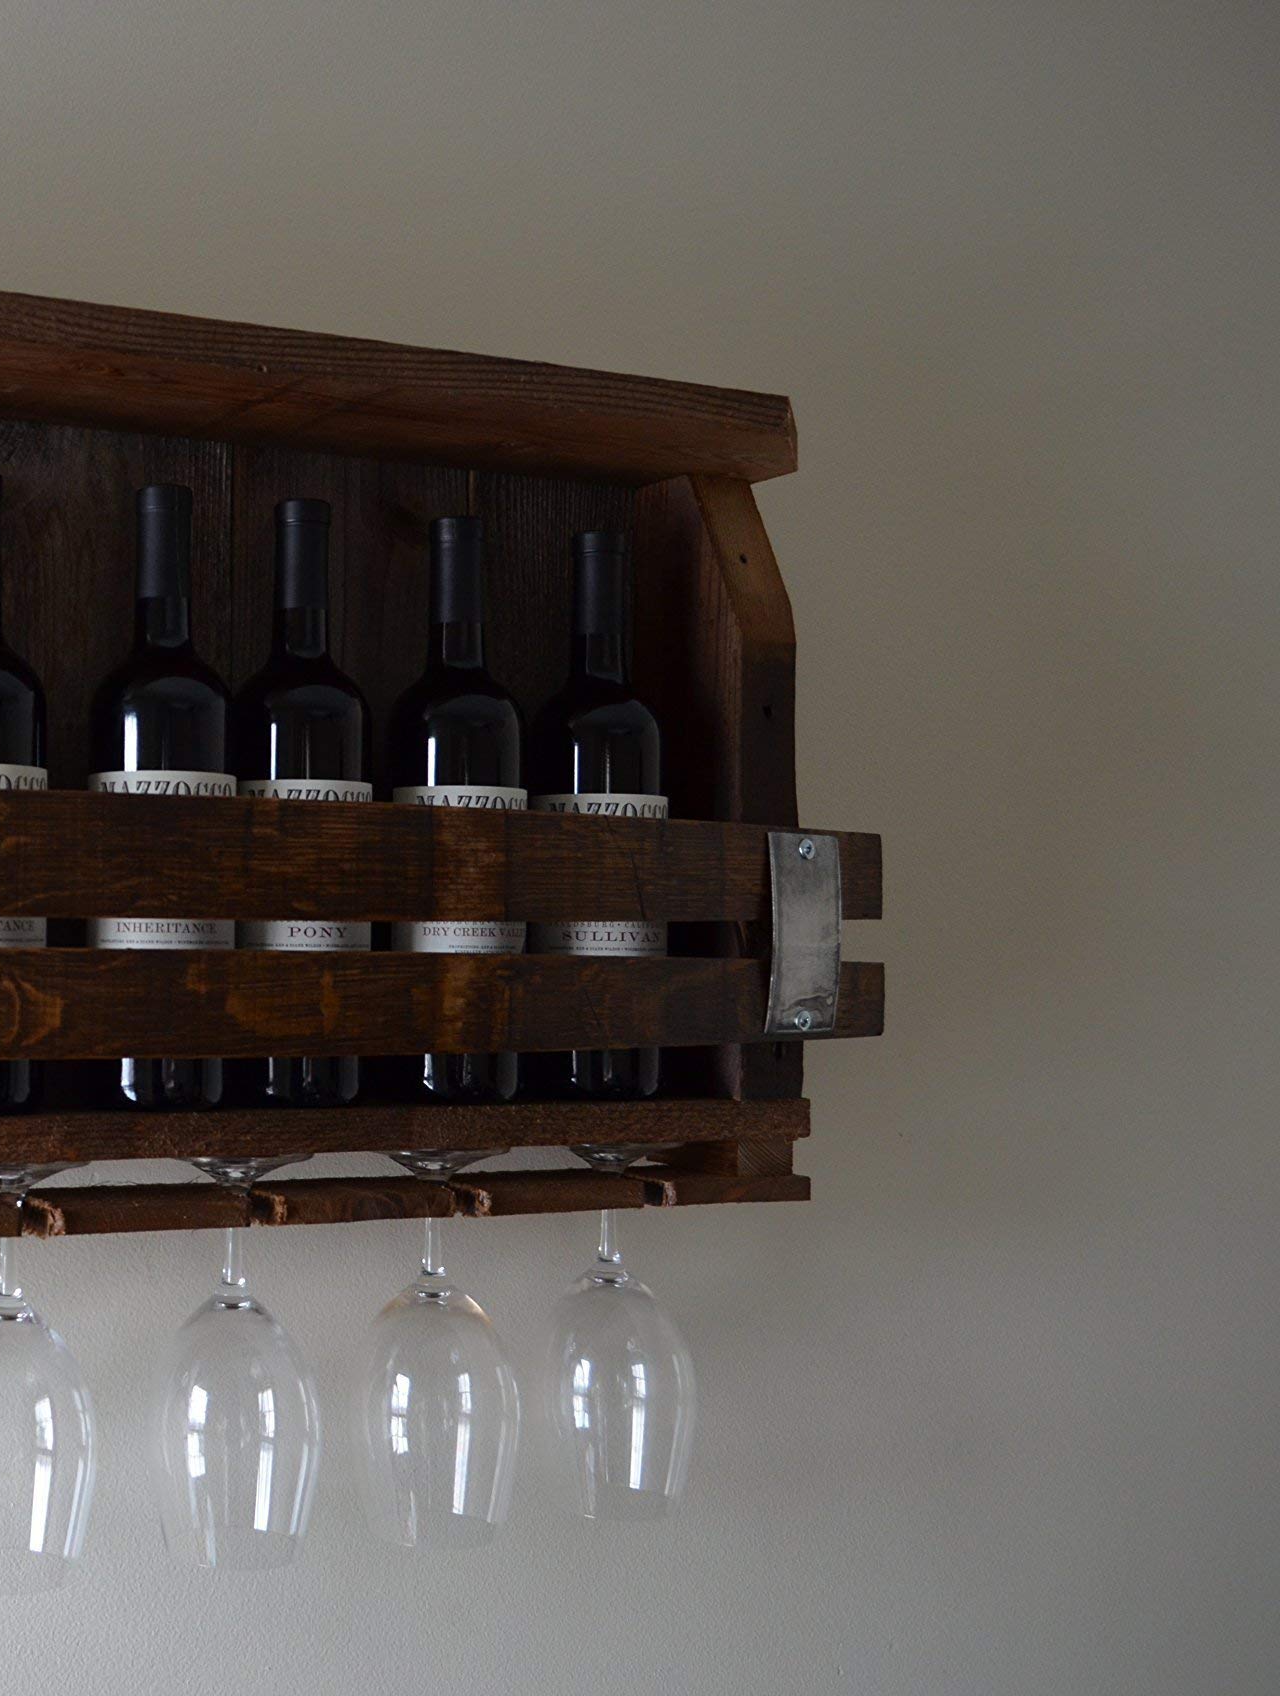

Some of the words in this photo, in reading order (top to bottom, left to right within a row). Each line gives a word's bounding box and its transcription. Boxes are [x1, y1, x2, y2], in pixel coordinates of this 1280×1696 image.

[116, 921, 217, 934] INHERITANCE
[288, 926, 348, 938] PONY
[423, 927, 450, 938] DRY
[453, 927, 496, 938] CREEK
[561, 930, 661, 943] SULLIVAN
